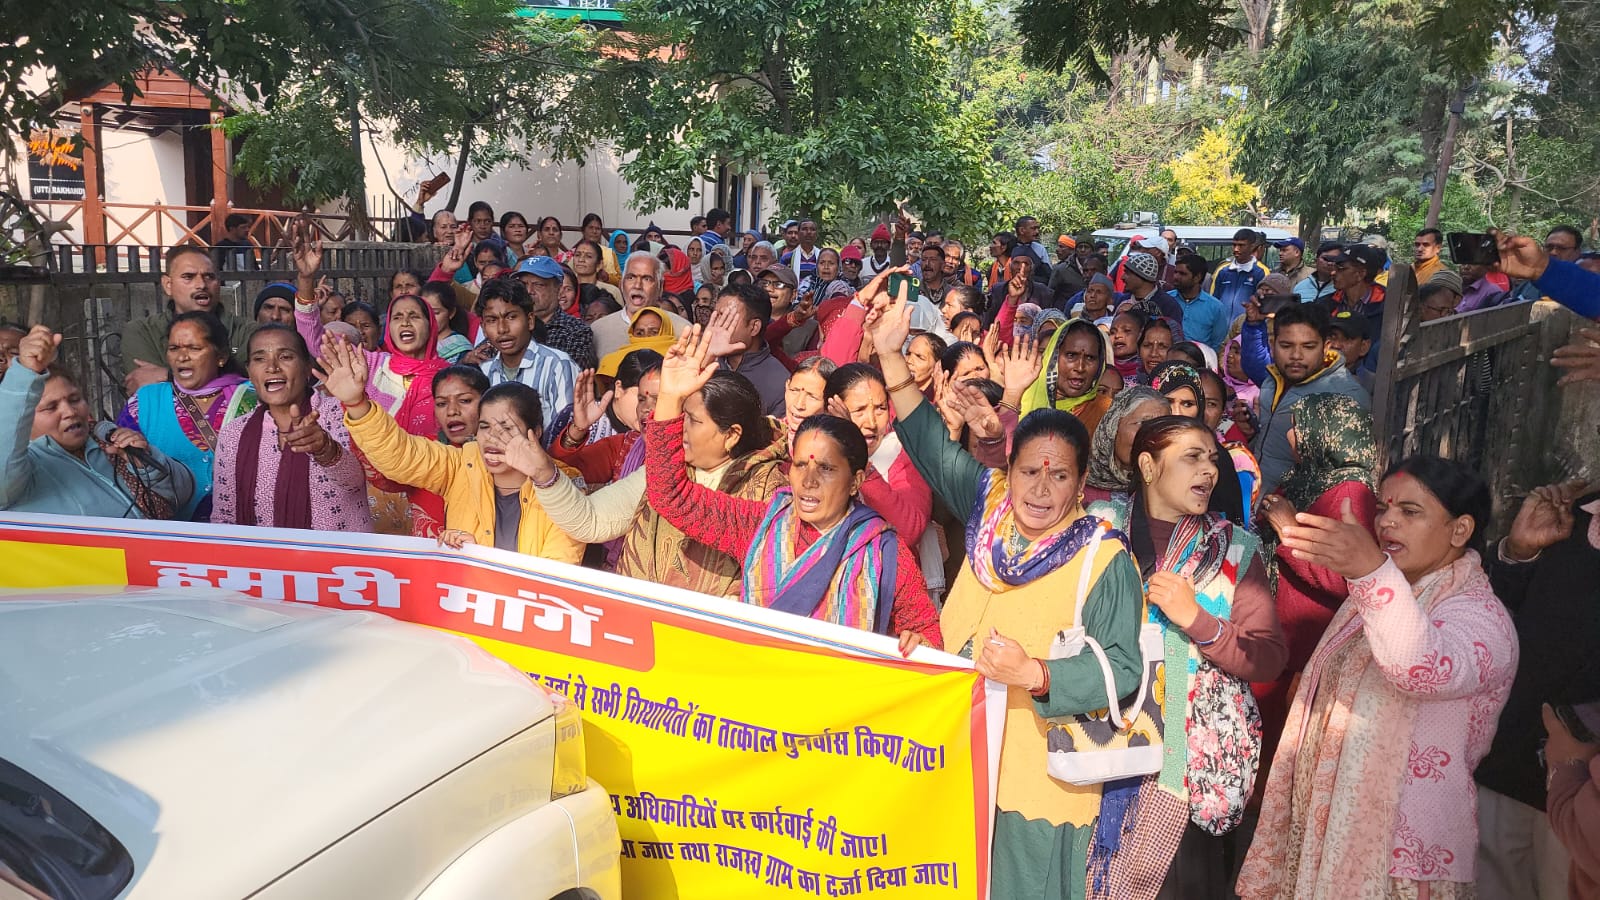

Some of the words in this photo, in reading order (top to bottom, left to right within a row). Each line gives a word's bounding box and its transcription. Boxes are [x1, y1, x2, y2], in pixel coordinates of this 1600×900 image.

[573, 674, 588, 712] से
[591, 682, 623, 720] सभी
[621, 686, 700, 738] विस्थापितों
[692, 712, 716, 744] का
[717, 717, 778, 753] तत्काल
[781, 727, 850, 760] पुनर्वास
[853, 725, 904, 766] किया
[623, 791, 718, 830] अधिकारियों
[721, 808, 747, 830] पर
[816, 815, 837, 856] की
[637, 840, 675, 860] जाए
[677, 841, 710, 864] तथा
[713, 842, 763, 880] राजस्व
[764, 854, 794, 891] ग्राम
[797, 868, 821, 897] का
[825, 868, 862, 898] दर्जा
[866, 866, 907, 892] दिया
